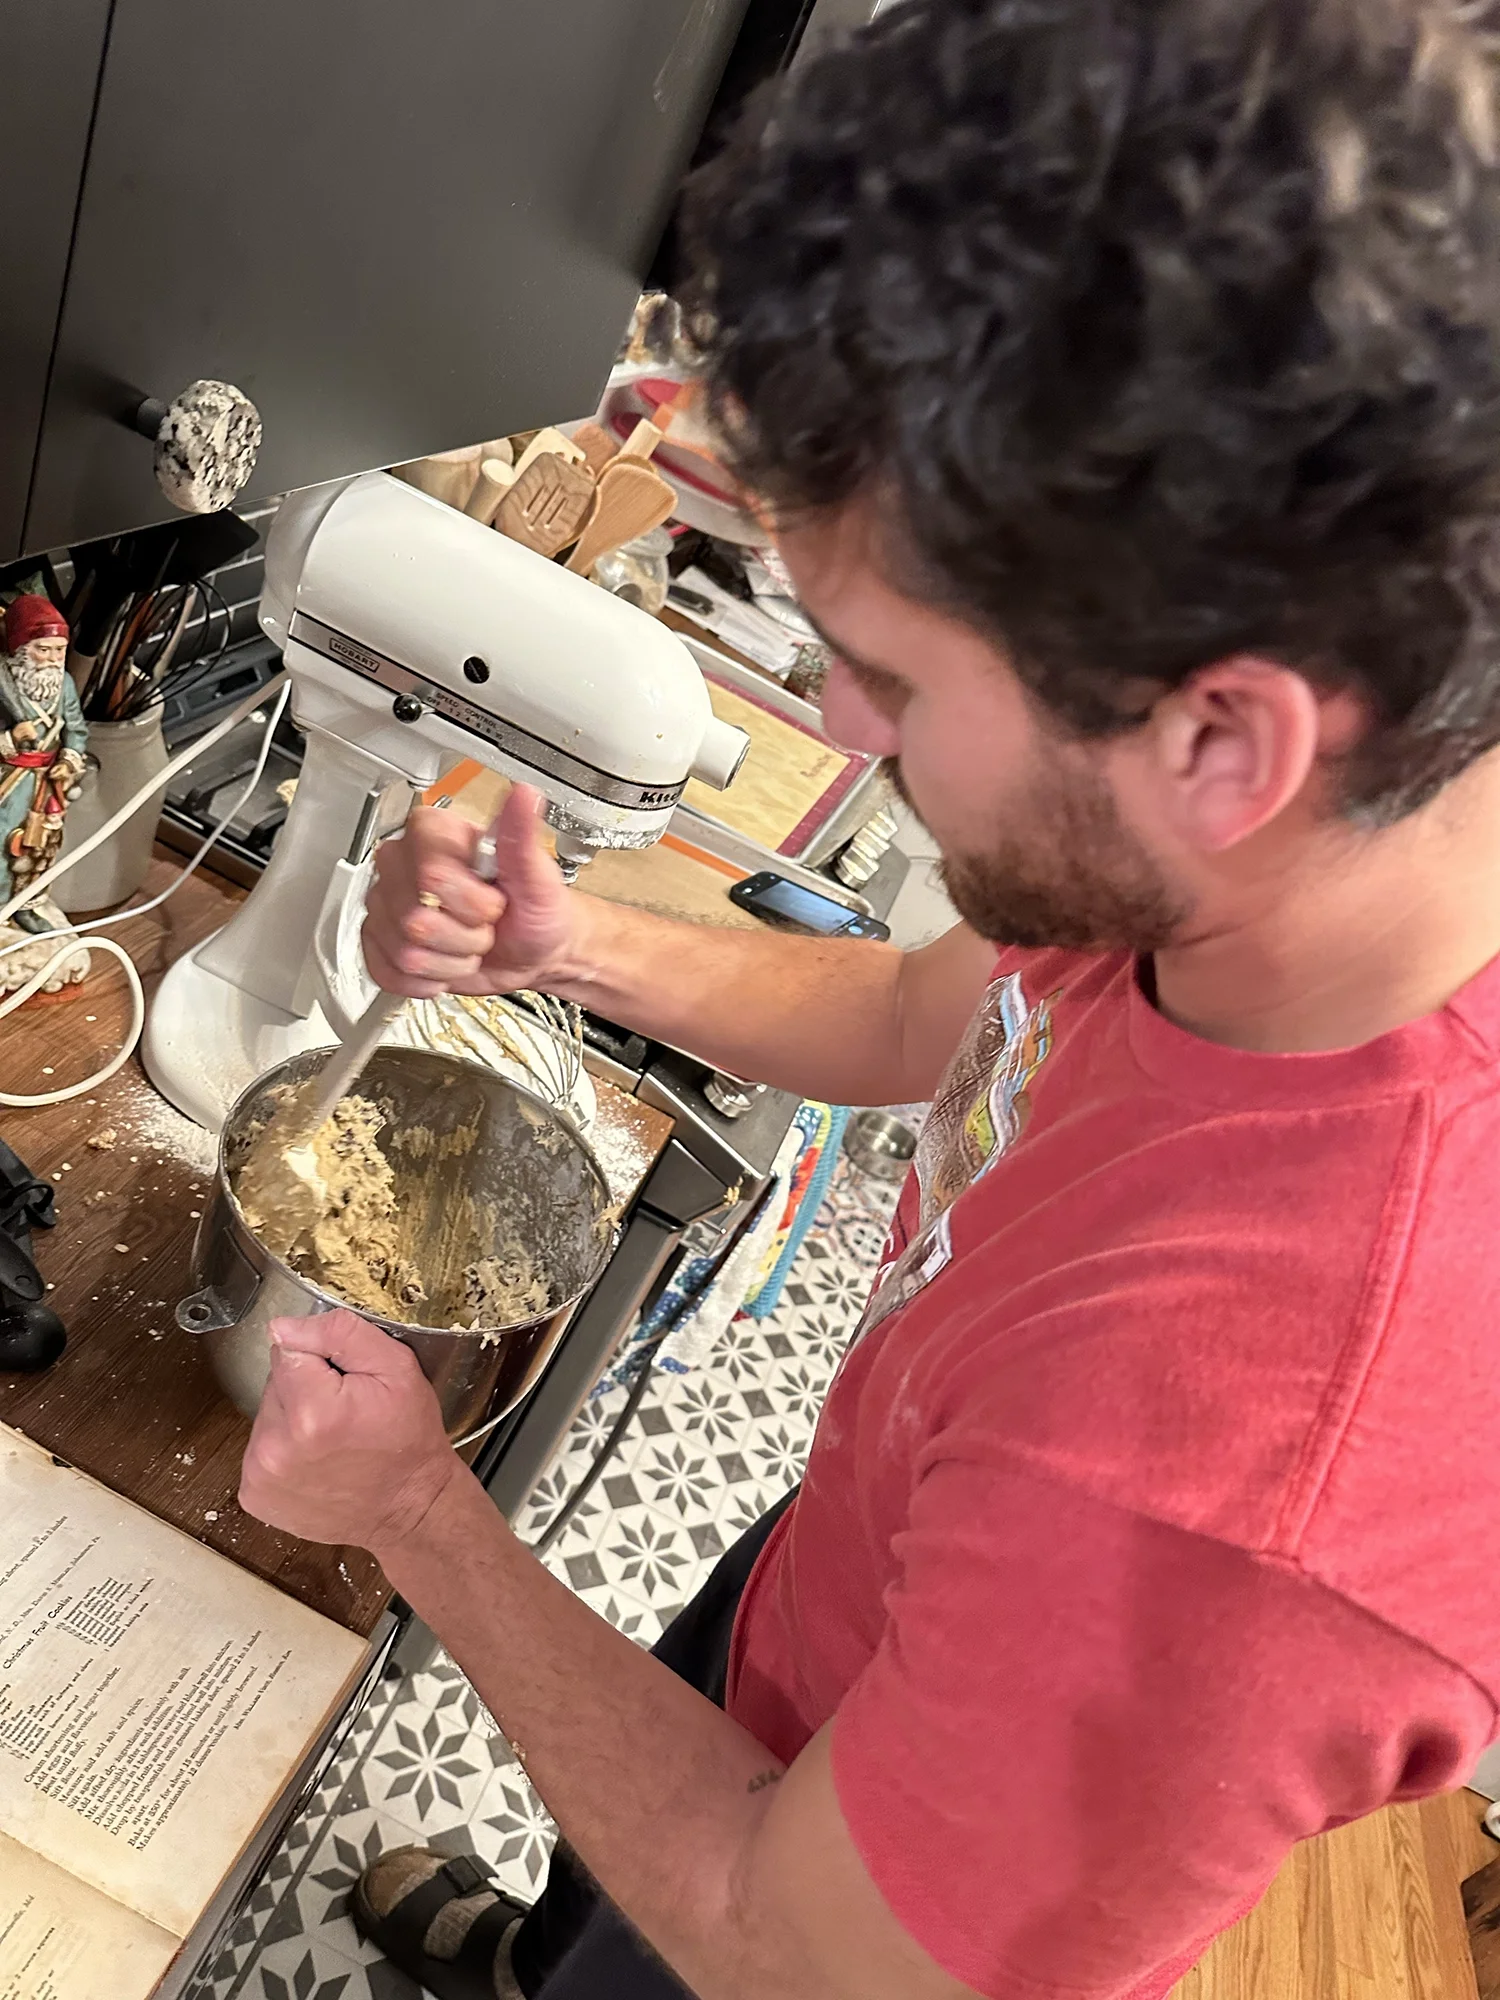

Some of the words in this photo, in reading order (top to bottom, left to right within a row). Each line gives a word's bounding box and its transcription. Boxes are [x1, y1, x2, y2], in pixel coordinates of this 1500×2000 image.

[333, 642, 376, 668] HOBART
[427, 696, 441, 707] OFF
[435, 692, 459, 708] SPEED
[464, 707, 497, 729] CONTROL
[1, 1636, 35, 1670] Christmas
[32, 1619, 49, 1636] Fruit
[46, 1594, 72, 1619] Cookies
[22, 1757, 47, 1784] Cream
[42, 1722, 76, 1759] shortening
[70, 1709, 86, 1723] and
[83, 1692, 100, 1710] sugar
[95, 1664, 122, 1693] together.
[30, 1771, 48, 1789] Add
[46, 1754, 64, 1772] eggs
[58, 1739, 74, 1754] and
[70, 1708, 99, 1740] flavoring.
[40, 1775, 58, 1794] Beat
[54, 1757, 72, 1776] until
[69, 1736, 90, 1758] fluffy.
[57, 1771, 85, 1804] Measure
[81, 1757, 97, 1772] and
[92, 1742, 108, 1758] add
[103, 1729, 118, 1743] salt
[113, 1716, 128, 1730] and
[124, 1695, 145, 1718] spices.
[74, 1797, 91, 1815] Add
[87, 1775, 107, 1797] sifted
[103, 1762, 118, 1777] dry
[113, 1725, 146, 1763] ingredients
[140, 1693, 170, 1727] alternately
[164, 1679, 180, 1695] with
[175, 1664, 191, 1680] milk.
[83, 1803, 100, 1820] Mix
[96, 1764, 129, 1804] thoroughly
[125, 1747, 141, 1765] after
[137, 1730, 153, 1748] each
[149, 1702, 174, 1731] addition.
[91, 1793, 119, 1825] Dissolve
[114, 1777, 131, 1795] soda
[136, 1729, 166, 1766] tablespoon
[161, 1712, 178, 1731] water
[173, 1700, 187, 1714] and
[182, 1683, 199, 1702] blend
[194, 1671, 208, 1685] well
[203, 1659, 217, 1673] into
[100, 1812, 117, 1830] Add
[113, 1781, 141, 1814] chopped
[136, 1761, 154, 1782] fruits
[149, 1748, 164, 1763] and
[159, 1733, 174, 1749] nuts
[170, 1720, 184, 1735] and
[179, 1703, 197, 1721] blend
[192, 1689, 206, 1704] well
[202, 1676, 216, 1690] into
[109, 1814, 130, 1837] Drop
[124, 1803, 138, 1816] by
[132, 1761, 168, 1805] teaspoonfuls
[163, 1745, 178, 1762] onto
[174, 1721, 197, 1747] greased
[191, 1700, 211, 1723] baking
[126, 1825, 145, 1846] Bake
[159, 1787, 172, 1800] for
[167, 1767, 186, 1789] about
[188, 1733, 210, 1759] minutes
[211, 1710, 226, 1726] until
[221, 1691, 240, 1712] lightly
[235, 1664, 258, 1692] browned.
[49, 1784, 64, 1799] Sift
[60, 1764, 79, 1784] flour.
[66, 1795, 81, 1809] Sift
[77, 1771, 99, 1796] again.
[130, 1802, 151, 1826] apart.
[136, 1826, 157, 1852] Makes
[153, 1778, 192, 1827] approximately
[194, 1747, 212, 1768] dozen
